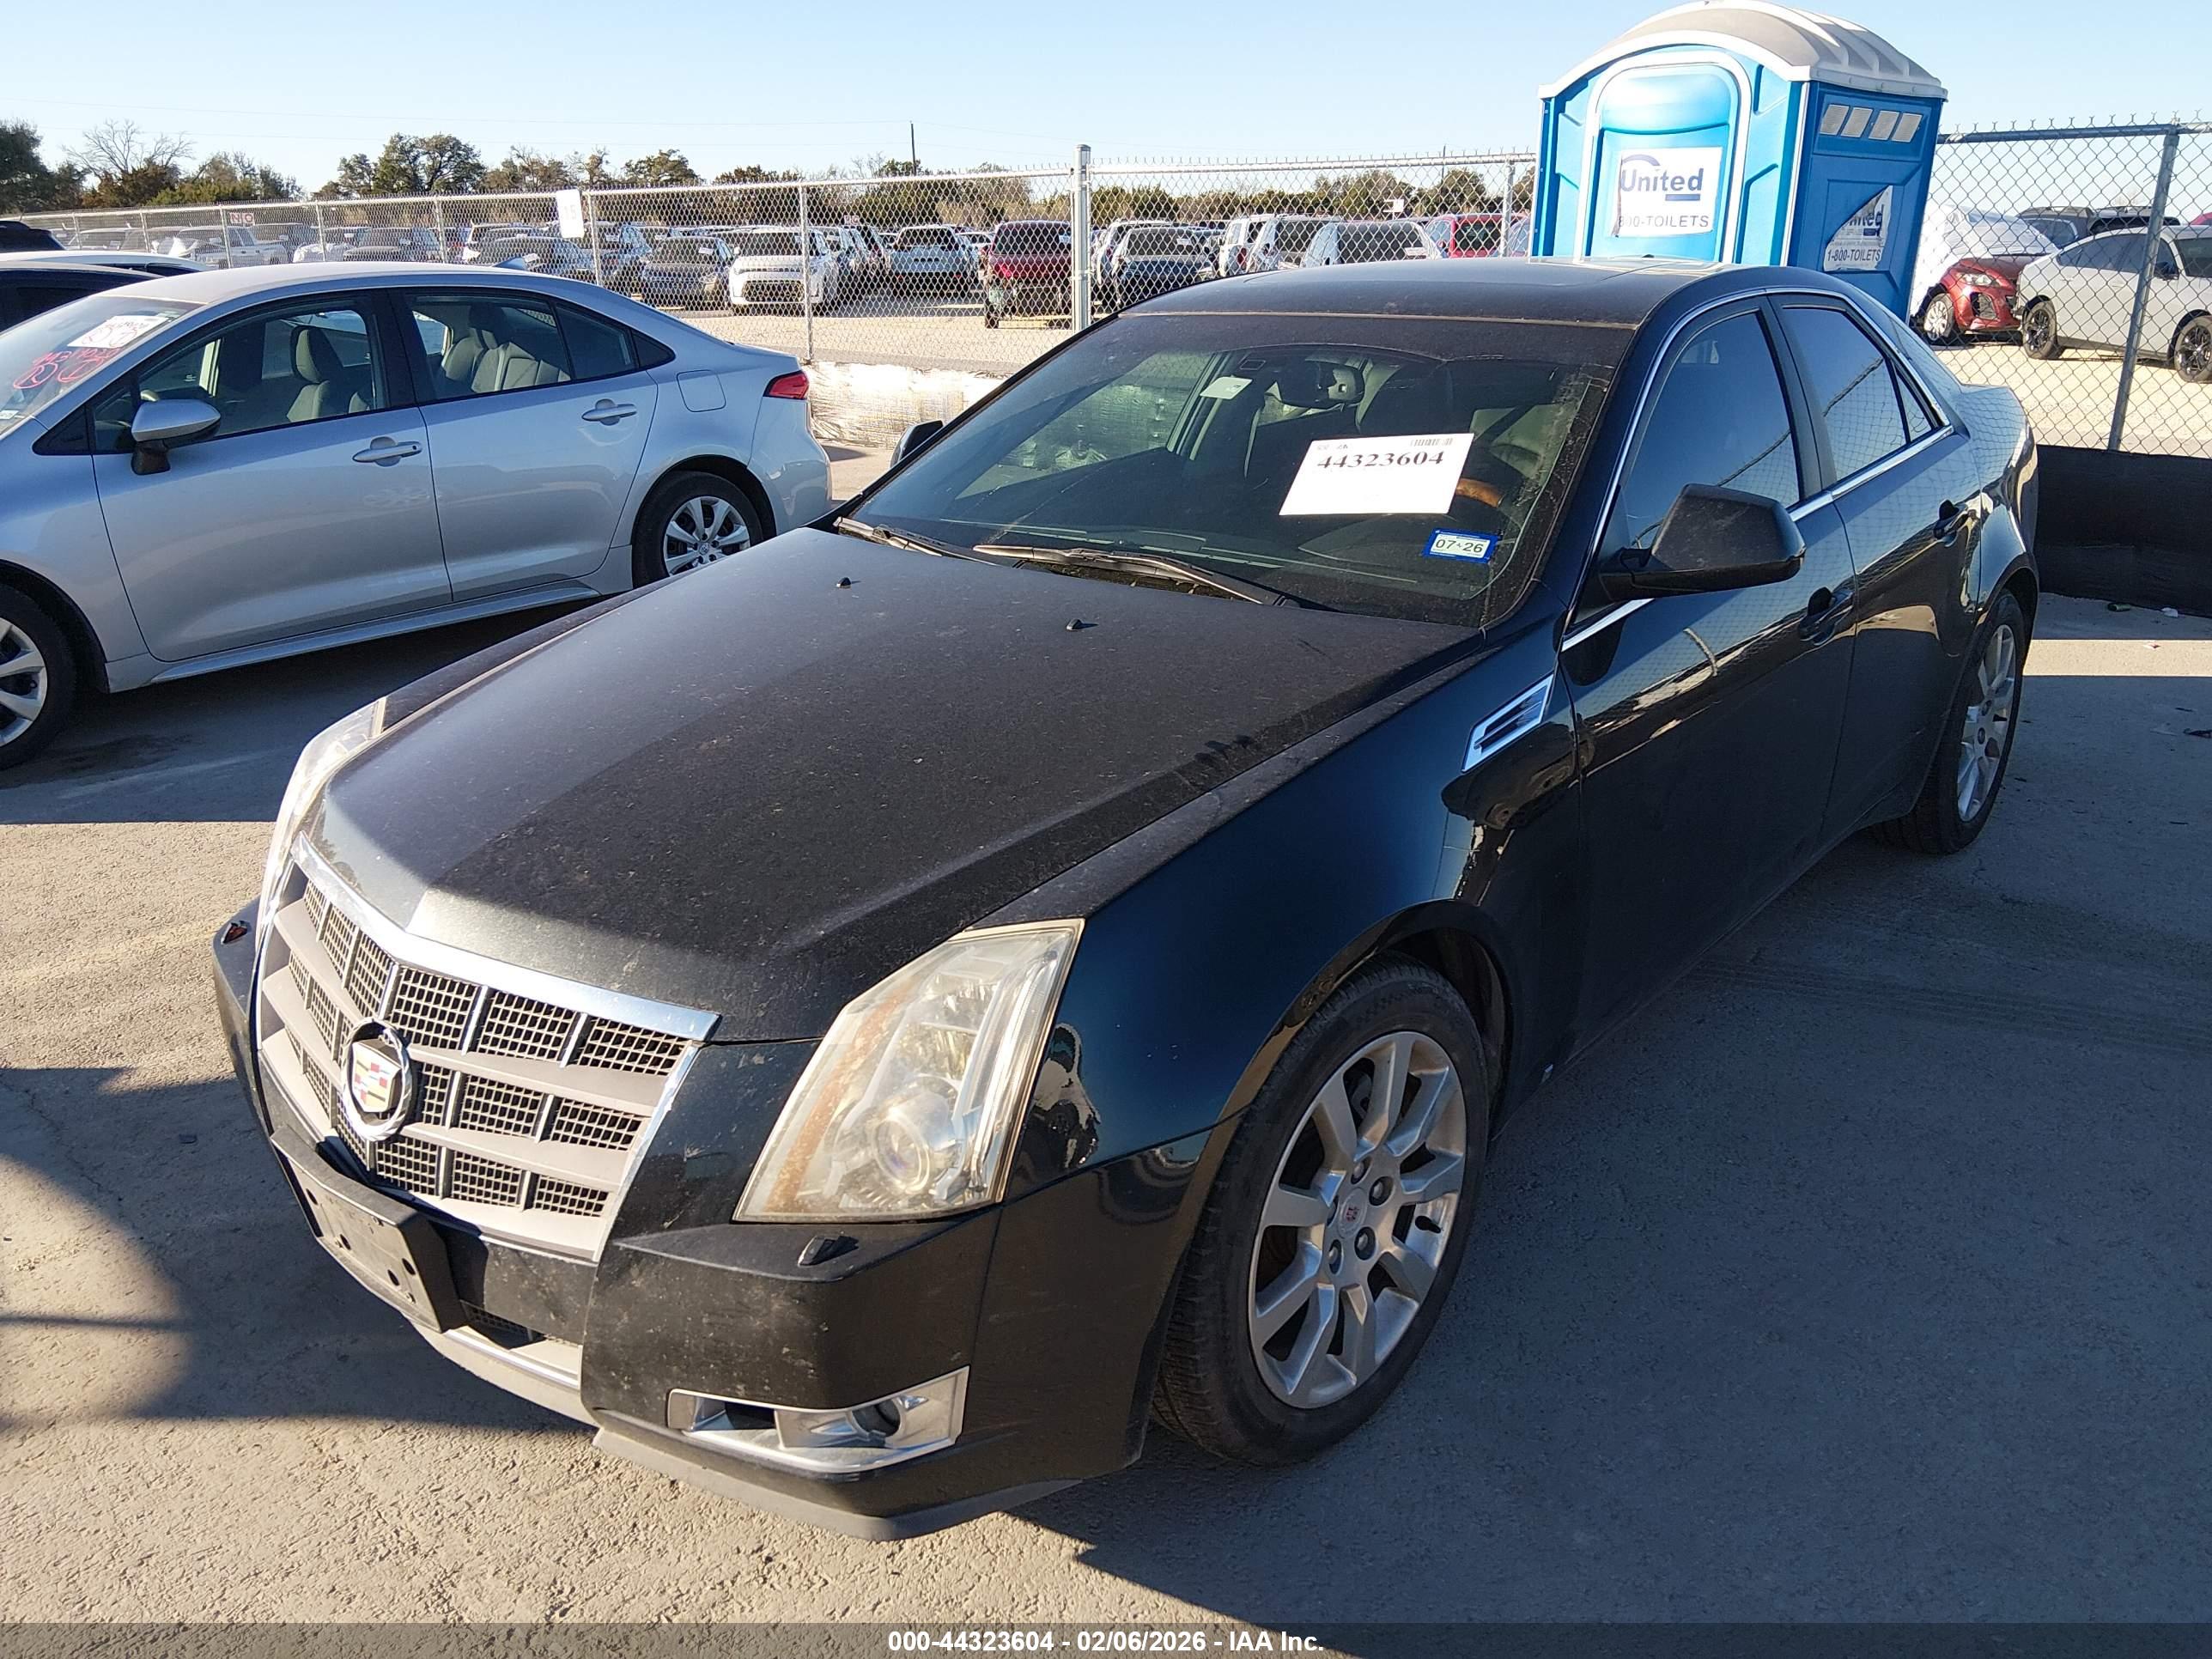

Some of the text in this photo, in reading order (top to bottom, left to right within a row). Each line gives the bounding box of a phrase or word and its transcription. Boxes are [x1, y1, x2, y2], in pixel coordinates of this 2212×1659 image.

[1620, 166, 1705, 192] United
[1826, 248, 1882, 263] 1-800-TOILETS
[1317, 451, 1444, 469] 44323604
